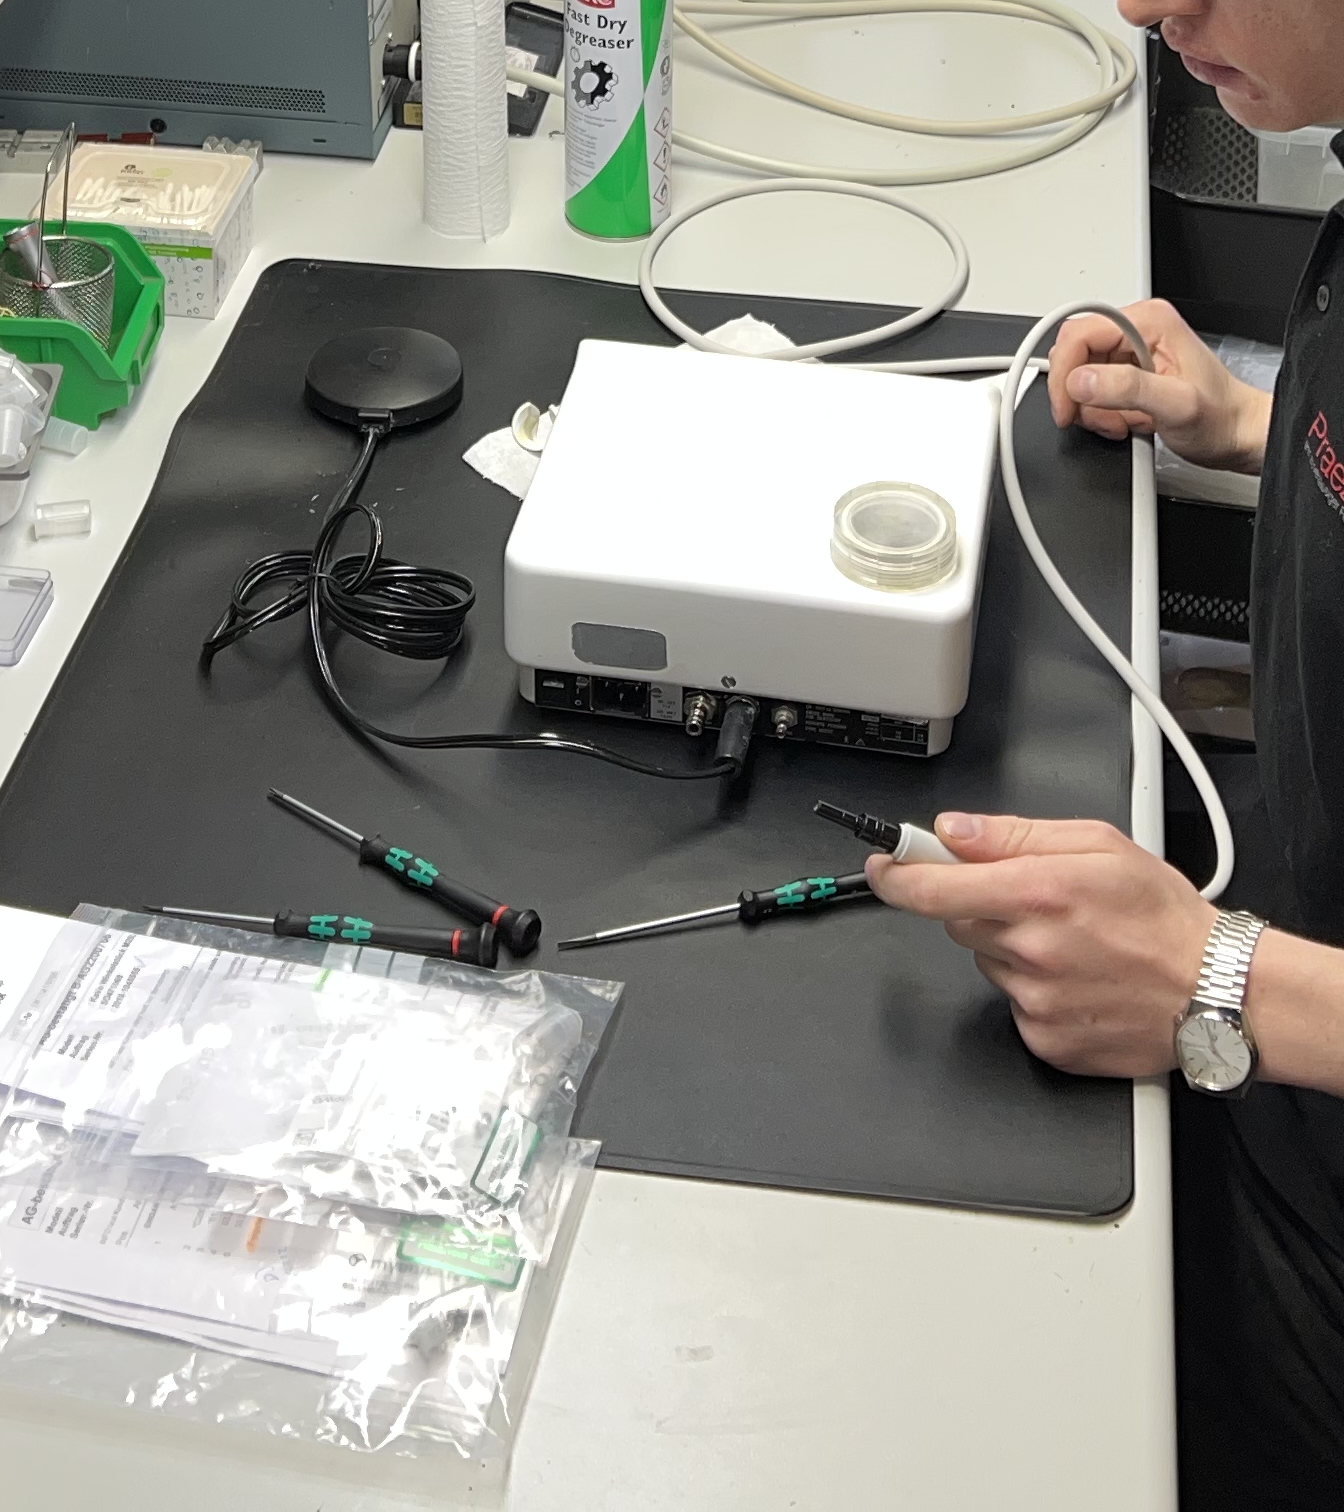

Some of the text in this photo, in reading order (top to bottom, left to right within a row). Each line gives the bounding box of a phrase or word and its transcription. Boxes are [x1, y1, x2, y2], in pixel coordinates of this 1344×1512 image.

[566, 0, 627, 35] Fast Dry
[564, 20, 634, 50] Degreaser
